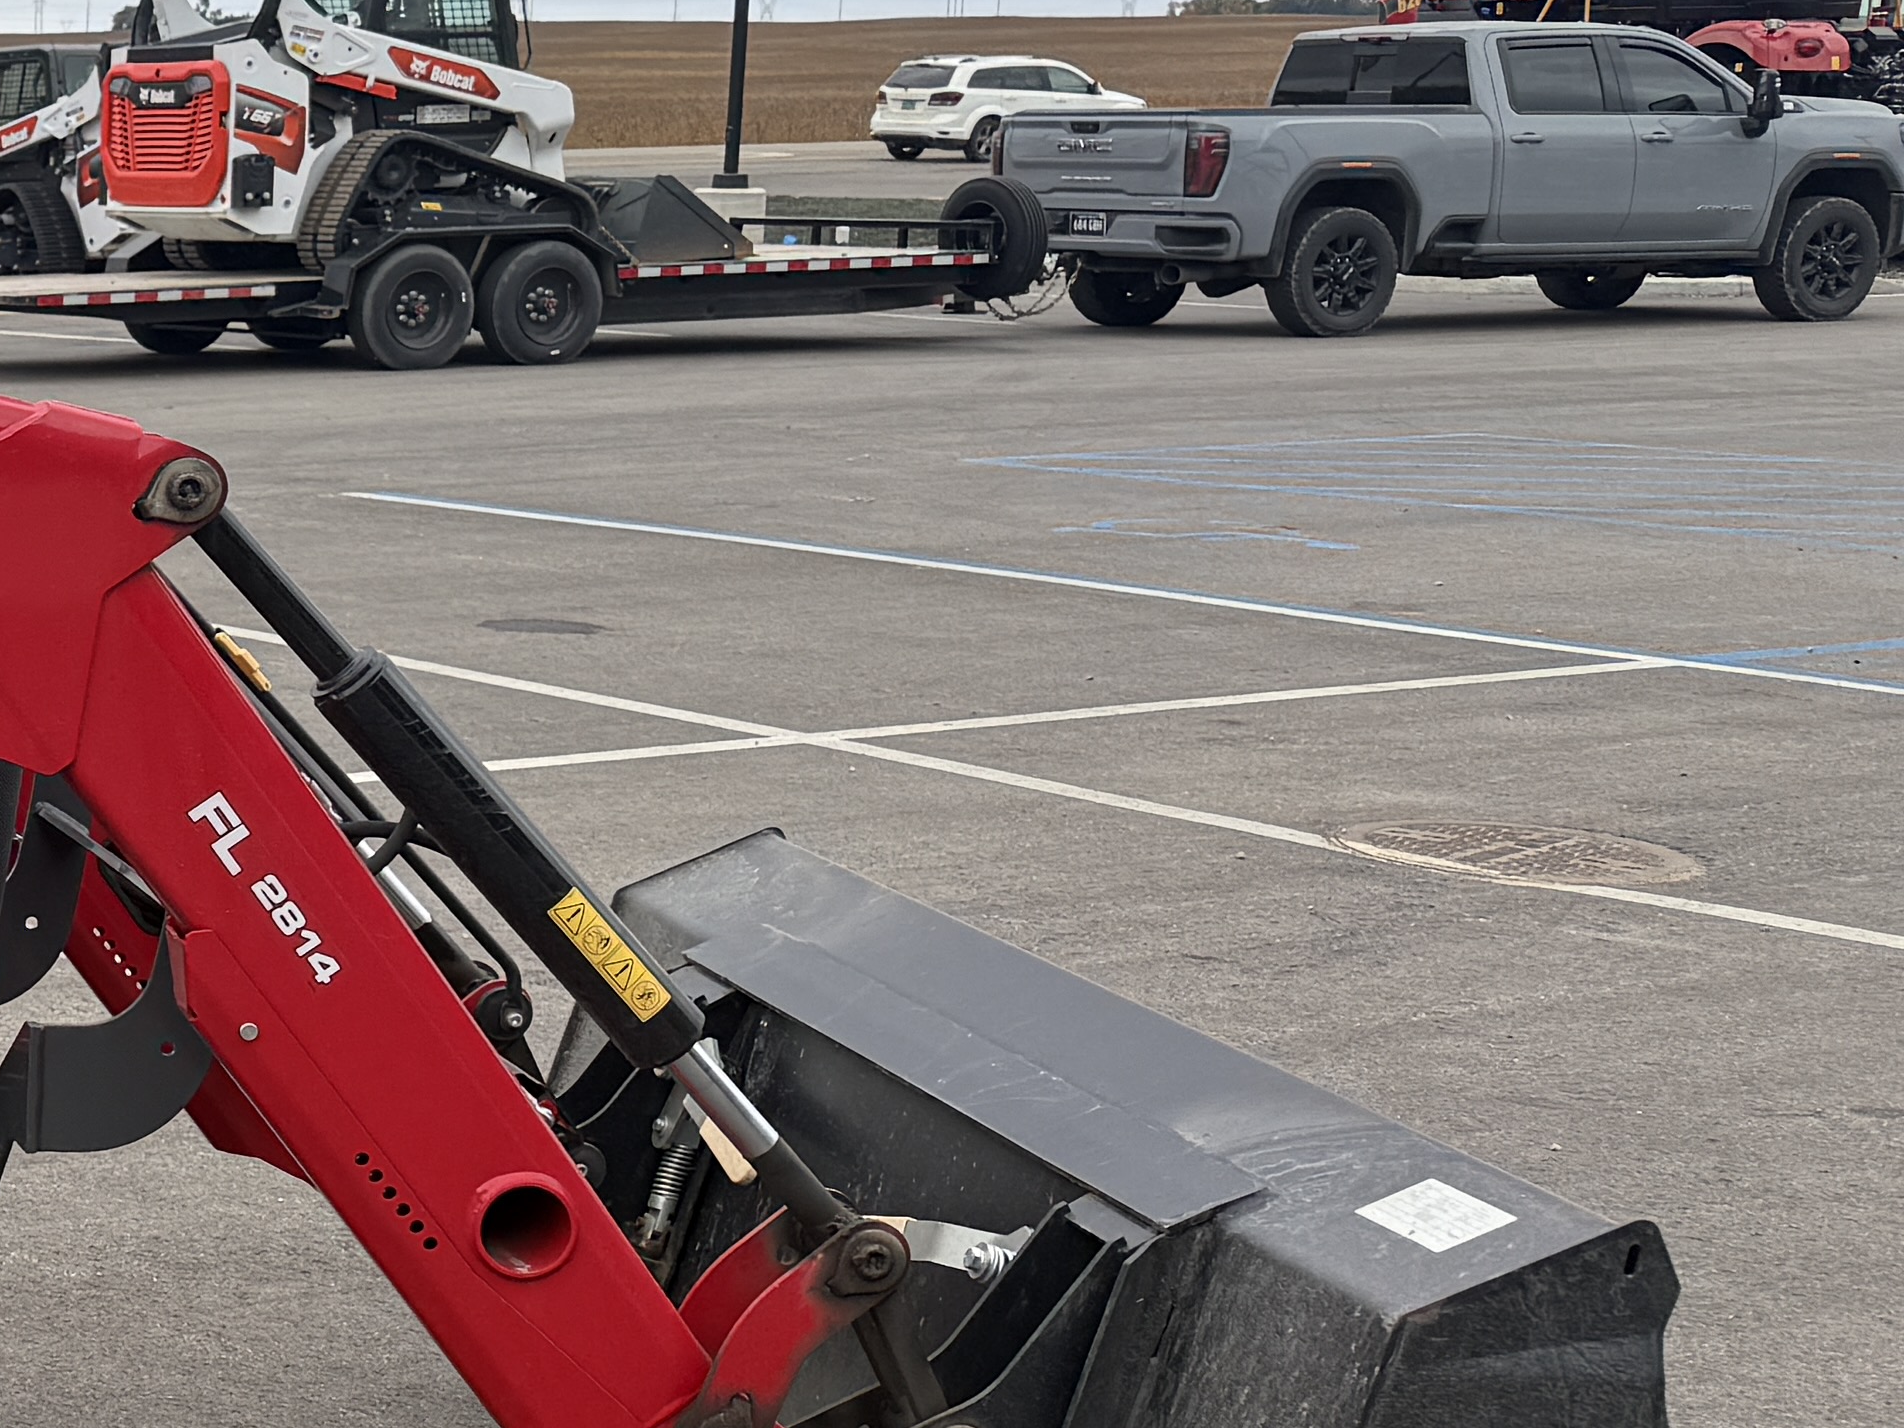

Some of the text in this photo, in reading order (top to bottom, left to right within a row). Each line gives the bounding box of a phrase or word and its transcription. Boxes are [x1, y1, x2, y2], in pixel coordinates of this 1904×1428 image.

[429, 64, 476, 92] Bobcat
[188, 791, 341, 984] FL 2814
